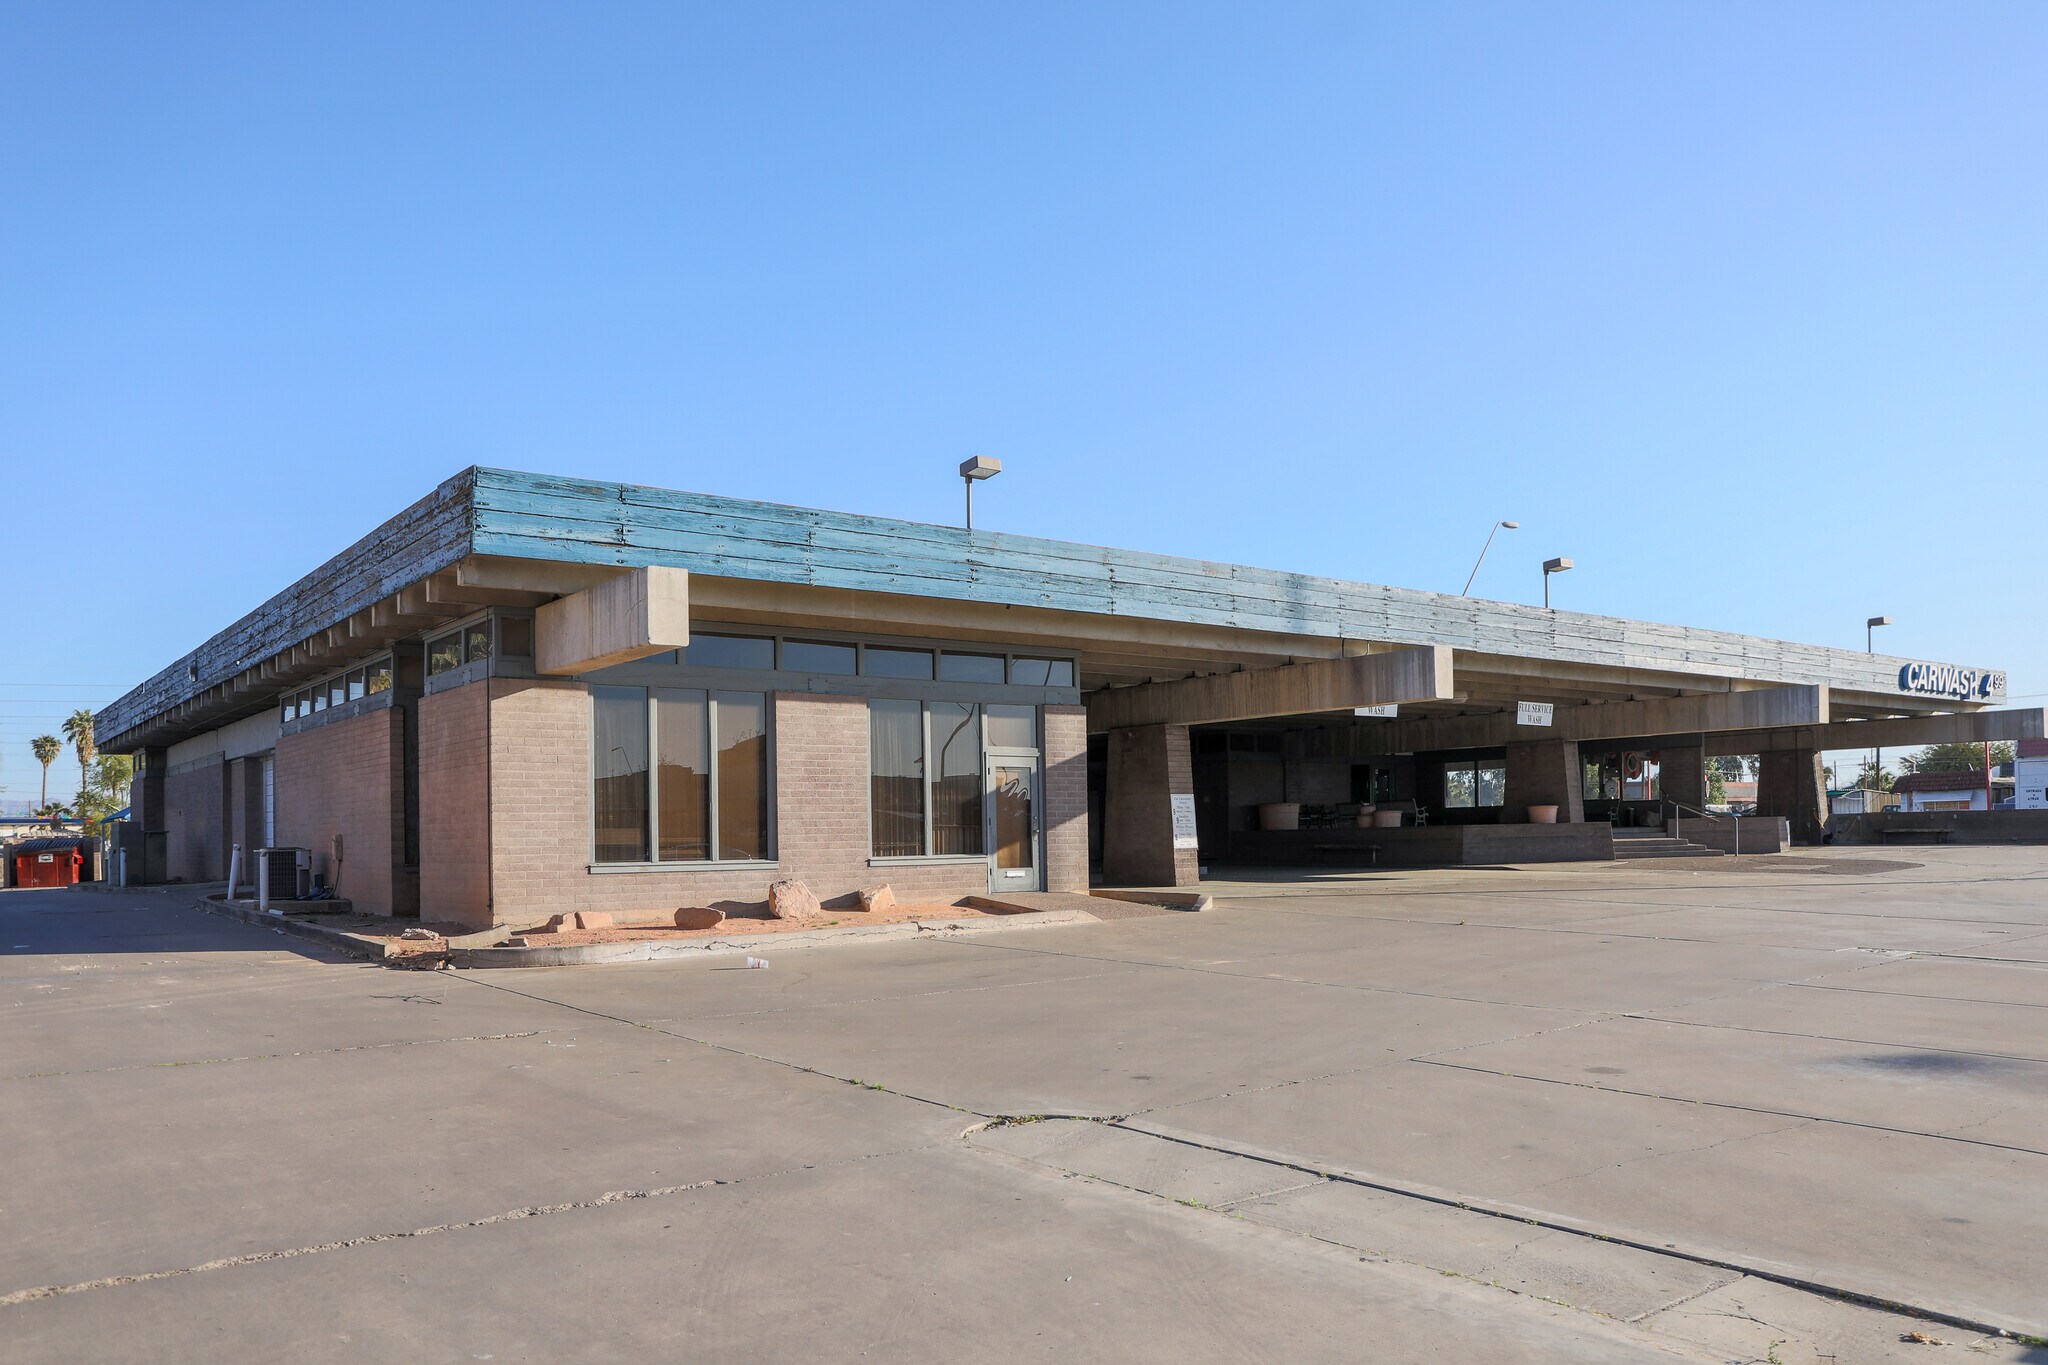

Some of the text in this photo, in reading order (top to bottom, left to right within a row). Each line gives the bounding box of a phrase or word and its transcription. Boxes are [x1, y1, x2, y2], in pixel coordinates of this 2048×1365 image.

[1905, 662, 1979, 699] CARWASH
[1367, 706, 1386, 715] WASH
[1518, 702, 1553, 714] FULL SERVICE
[1527, 714, 1543, 724] WASH
